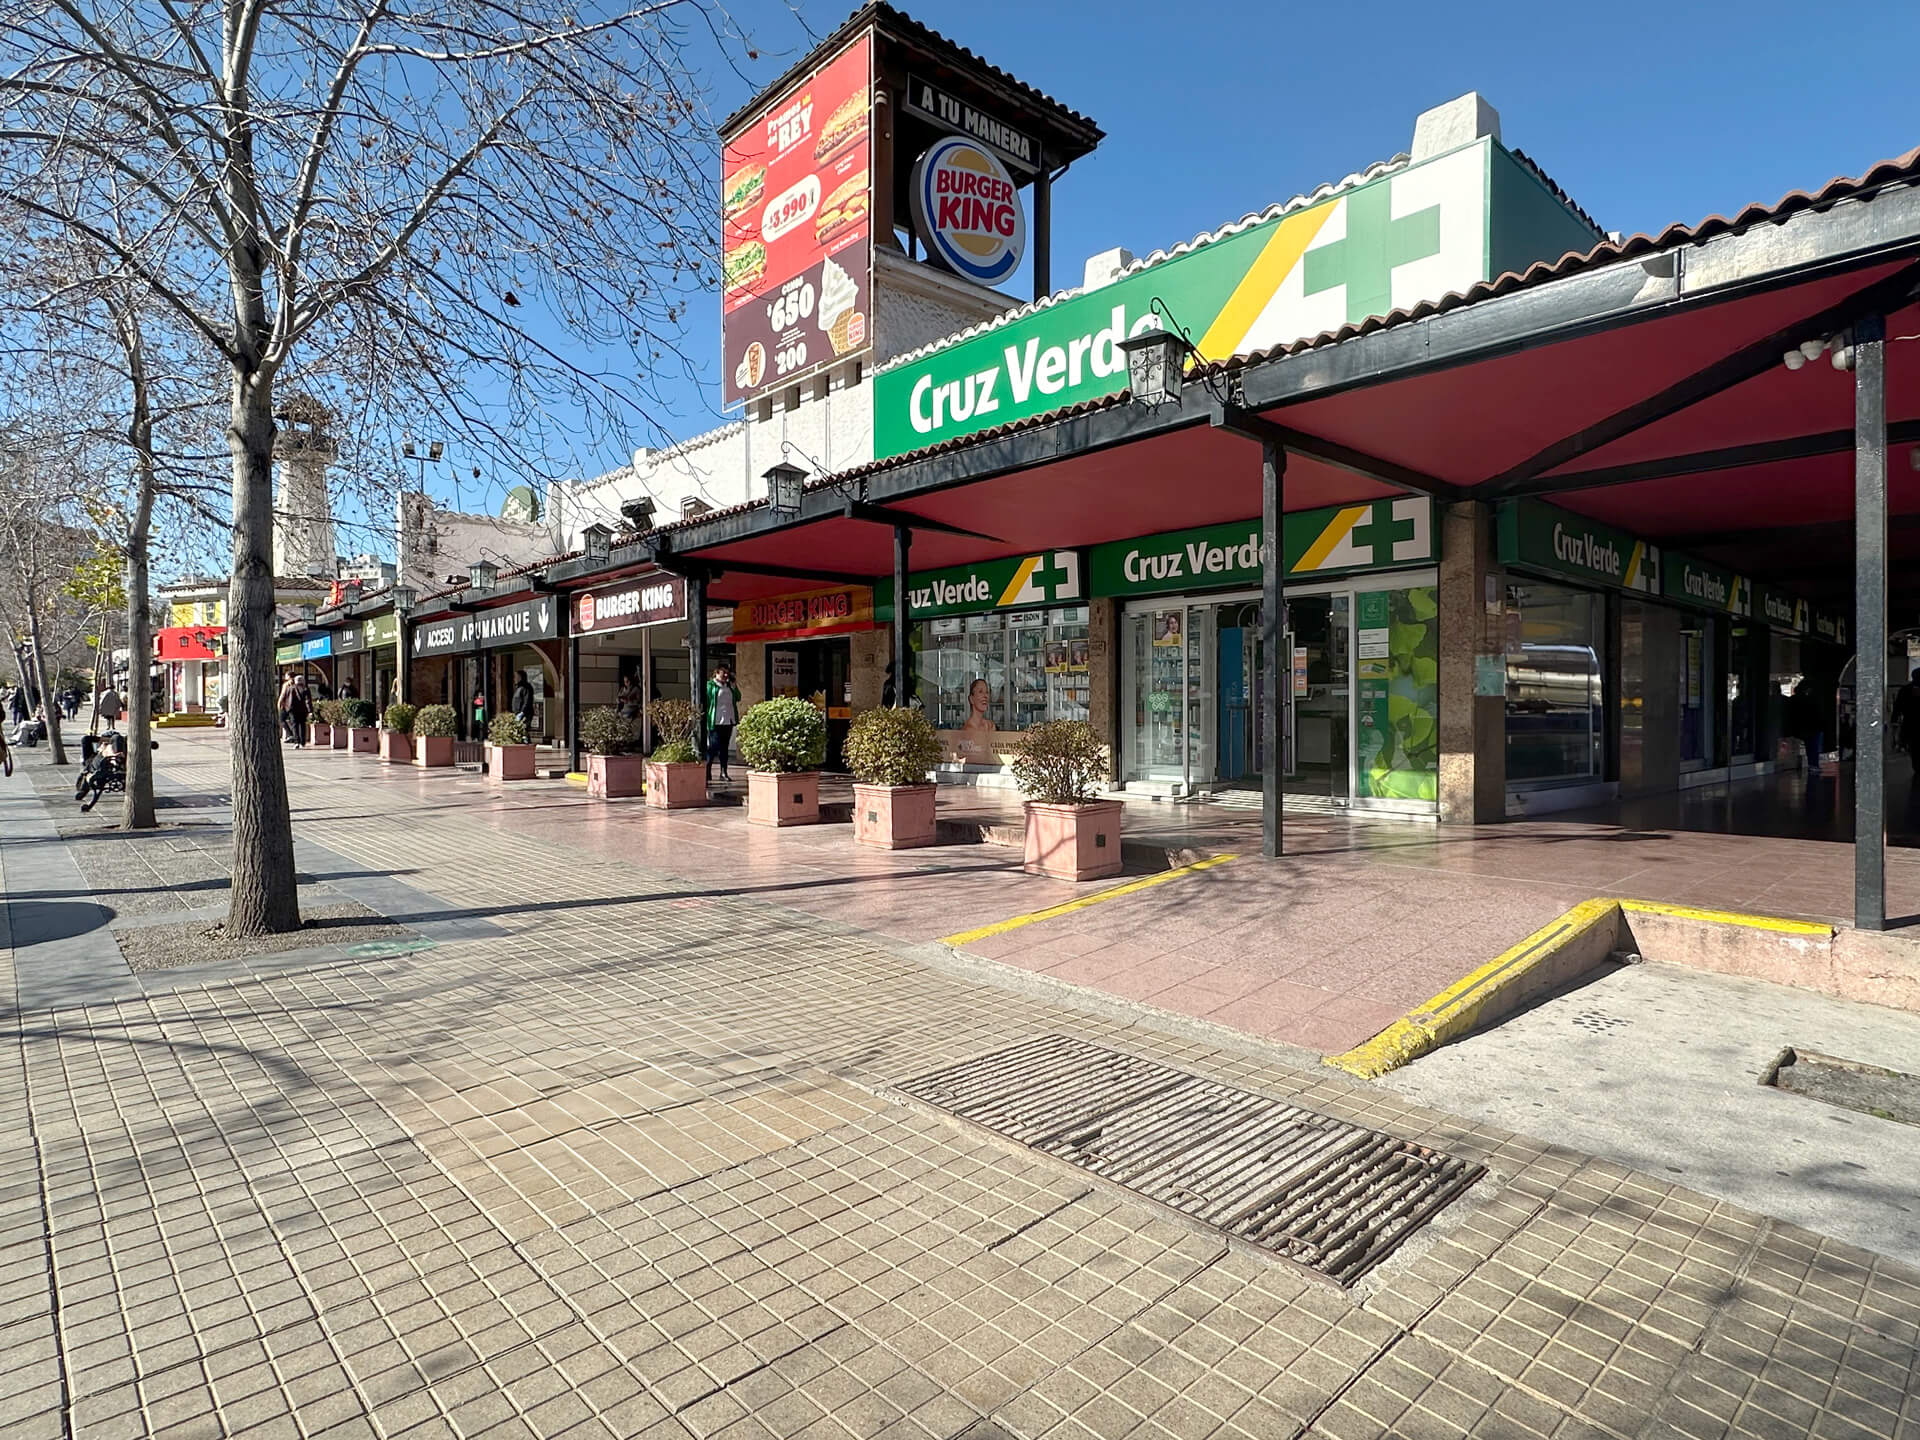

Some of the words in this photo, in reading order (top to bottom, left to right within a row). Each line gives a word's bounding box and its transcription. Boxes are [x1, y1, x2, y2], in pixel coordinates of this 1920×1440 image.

[778, 103, 814, 153] REY
[921, 86, 934, 112] A
[939, 94, 960, 124] TU
[965, 107, 1030, 161] MANERA
[936, 169, 1013, 205] BURGER
[938, 196, 1015, 237] KING
[909, 366, 999, 434] Cruz
[1123, 550, 1183, 582] Cruz
[1553, 522, 1584, 566] Cruz
[1584, 533, 1620, 576] Verde
[596, 591, 640, 620] BURGER
[642, 584, 673, 611] KING
[932, 575, 990, 606] Verde
[1684, 564, 1702, 597] Cruz
[1702, 571, 1726, 603] Verde
[750, 600, 805, 626] BURGER
[808, 594, 848, 620] KING
[1023, 612, 1040, 623] ISDIN
[427, 627, 455, 648] ACCESO
[462, 611, 531, 642] APUMANQUE
